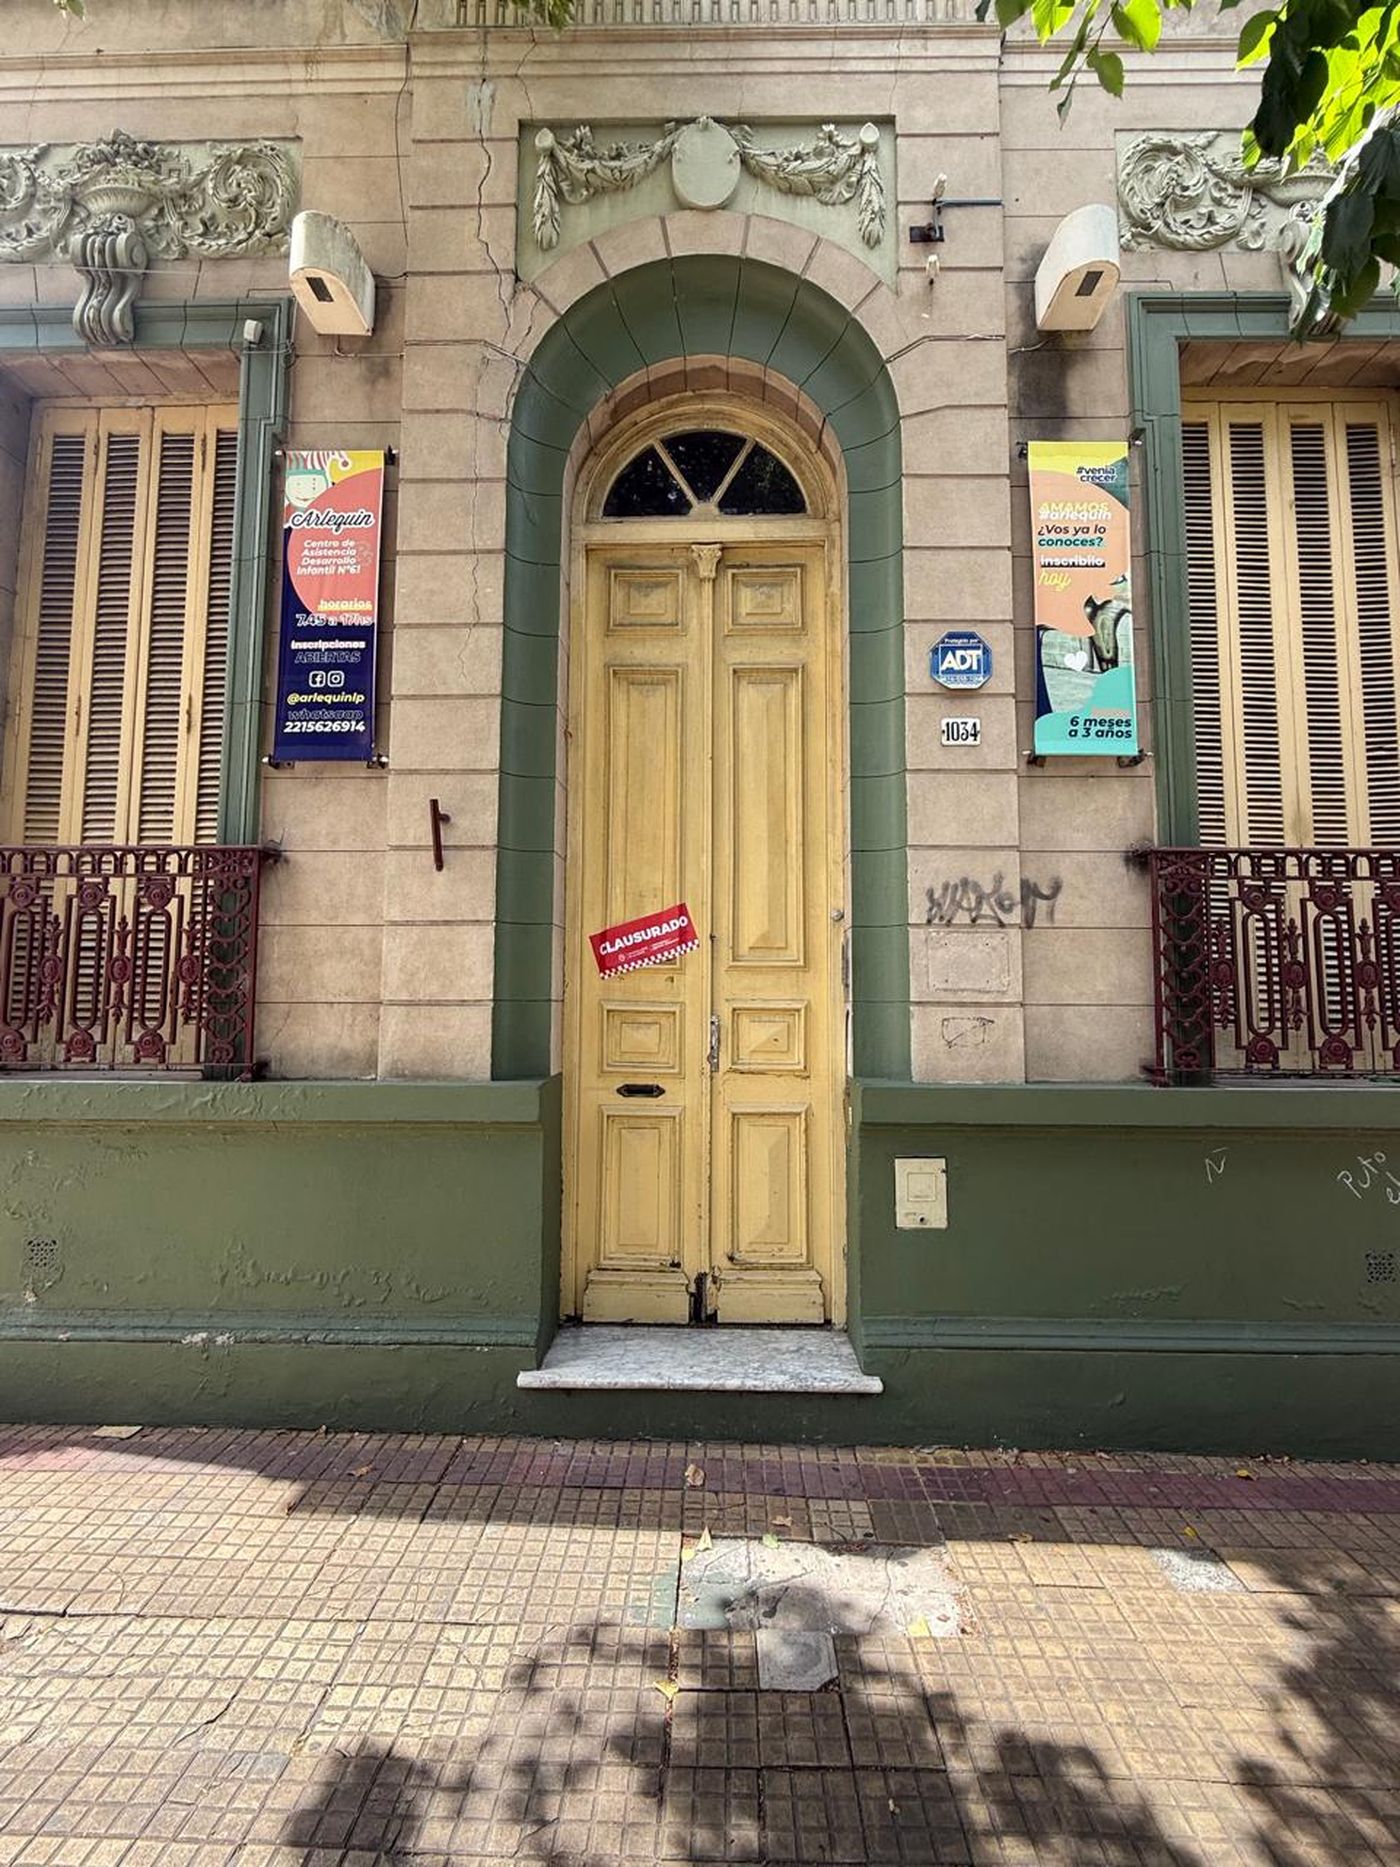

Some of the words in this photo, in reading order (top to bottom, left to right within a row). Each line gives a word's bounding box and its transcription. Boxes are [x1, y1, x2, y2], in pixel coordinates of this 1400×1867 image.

[1080, 474, 1116, 482] crecer
[1040, 502, 1109, 512] AMAMOS
[291, 508, 374, 533] Arlequin
[1038, 525, 1069, 536] ¿Vos
[1073, 528, 1090, 536] ya
[1094, 524, 1106, 535] lo
[303, 540, 340, 548] Centro
[341, 539, 355, 548] de
[1038, 537, 1103, 547] conoces?
[301, 547, 357, 557] Asistencia
[302, 557, 356, 566] Desarrollo
[297, 566, 336, 576] Infantil
[1039, 571, 1072, 592] hoy
[318, 599, 373, 612] horarios
[328, 616, 338, 627] a
[294, 651, 362, 663] ABIERTAS
[940, 649, 982, 670] ADT
[287, 692, 366, 705] @arlequinlp
[283, 720, 366, 733] 2215626914
[1069, 716, 1080, 727] 6
[1083, 718, 1132, 727] meses
[945, 721, 978, 741] 1034
[1068, 729, 1078, 738] a
[1082, 727, 1091, 738] 3
[1095, 727, 1132, 738] años
[599, 915, 688, 955] CLAUSURADO
[1337, 1152, 1386, 1199] Puto
